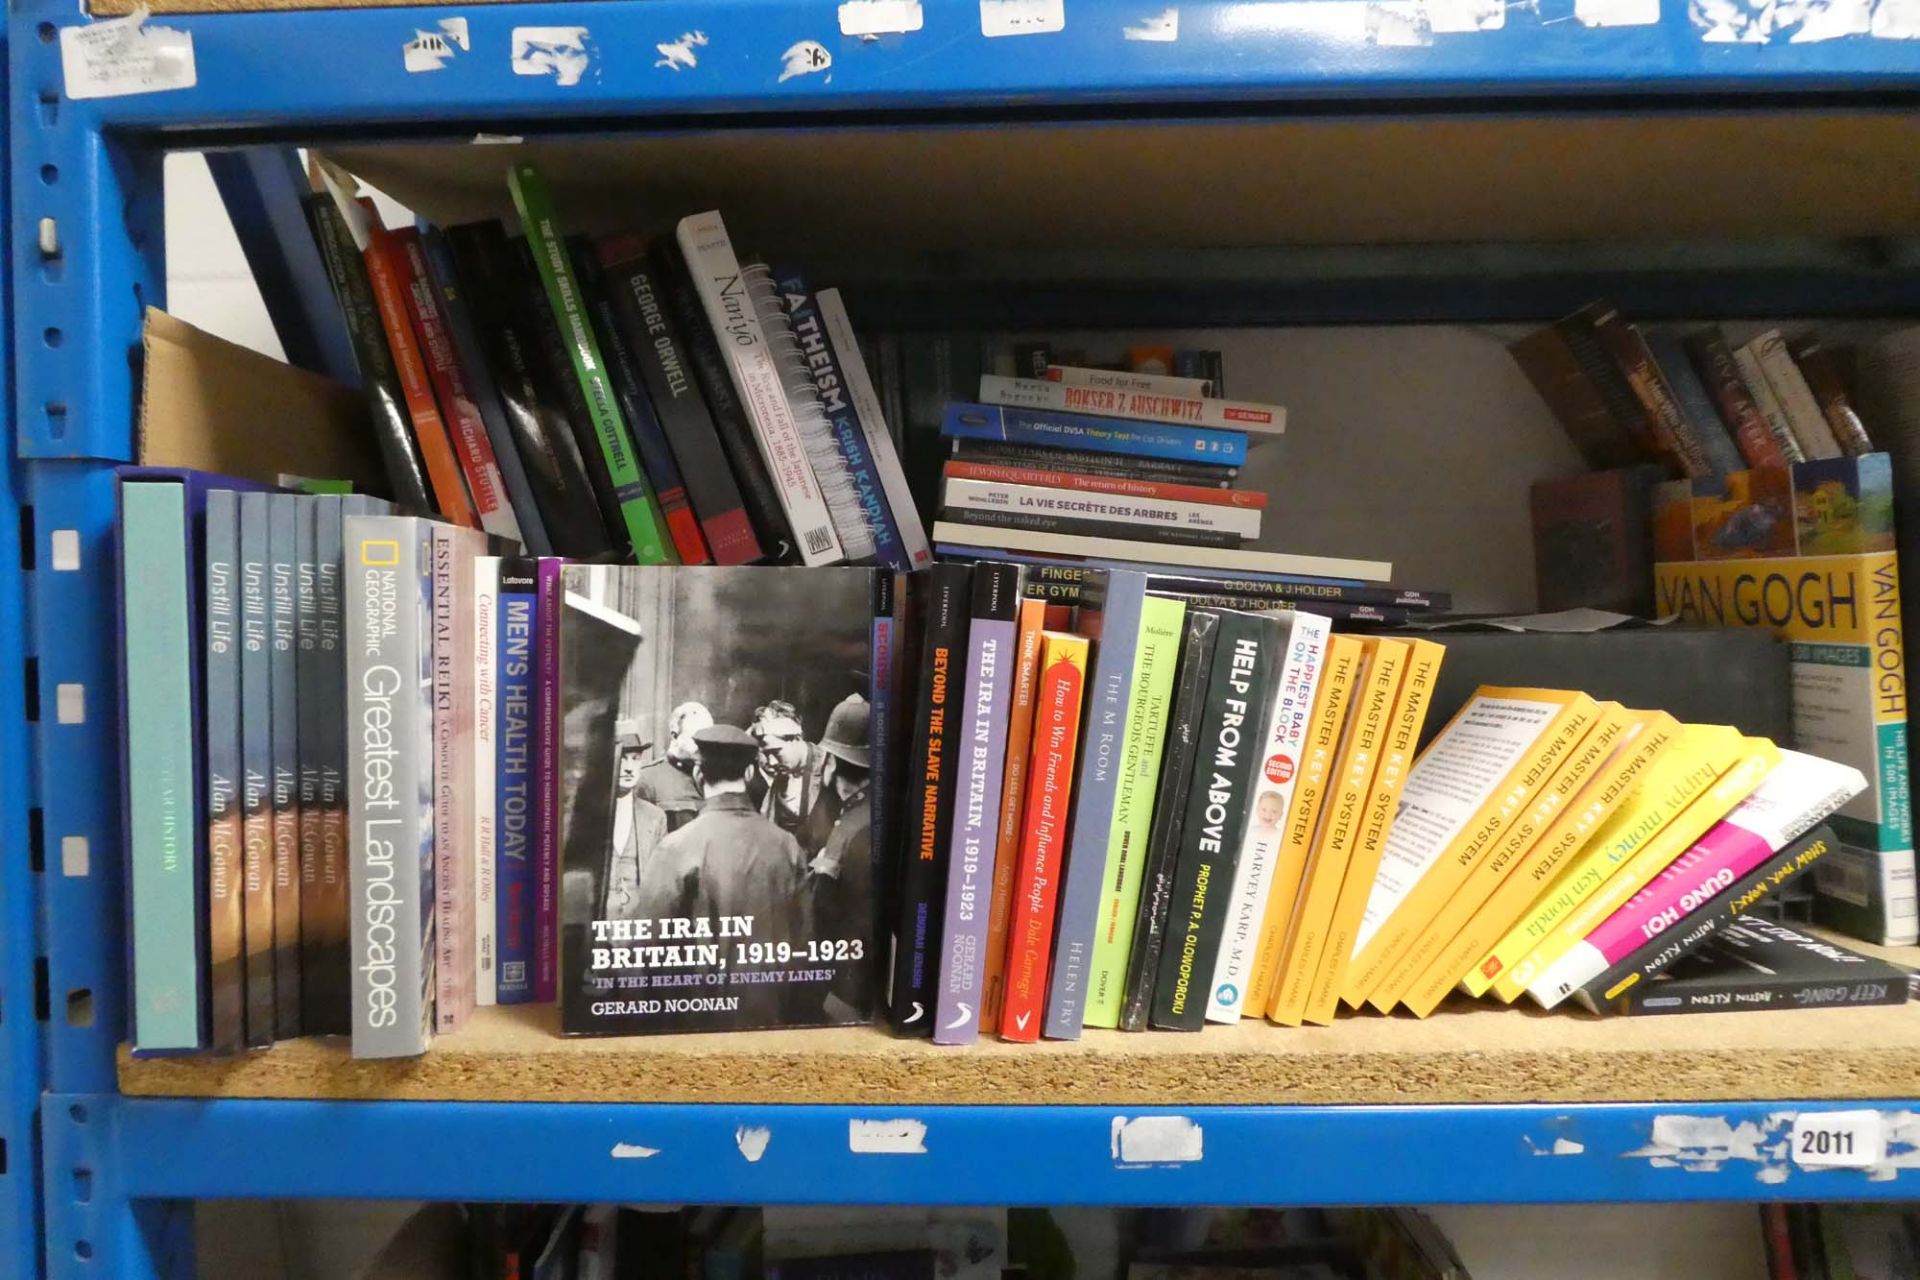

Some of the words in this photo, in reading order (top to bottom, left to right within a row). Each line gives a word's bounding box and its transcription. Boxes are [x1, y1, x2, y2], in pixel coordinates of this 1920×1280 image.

[539, 218, 554, 239] THE
[545, 239, 565, 273] STUDY
[556, 273, 577, 312] SKILLS
[567, 311, 597, 372] HANDBOOK
[628, 272, 666, 336] GEORGE
[651, 334, 690, 399] ORWELL
[1132, 378, 1153, 390] Free
[587, 373, 612, 417] STELLA
[601, 415, 629, 472] COTTRELL
[1129, 392, 1204, 422] AUSCHWITZ
[1033, 422, 1063, 435] Official
[1063, 424, 1085, 436] DVSA
[472, 463, 500, 511] STUTTLE
[833, 413, 865, 468] KRISH
[852, 467, 894, 548] KANDIAH
[1073, 477, 1088, 487] The
[1089, 479, 1117, 490] return
[1127, 482, 1157, 495] history
[963, 510, 994, 526] Beyond
[995, 513, 1012, 524] the
[1019, 496, 1034, 507] LA
[1036, 498, 1055, 509] VIE
[1056, 498, 1107, 515] SECRÈTE
[1110, 505, 1132, 517] DES
[1133, 507, 1179, 522] ARBRES
[211, 561, 230, 614] Unstill
[382, 570, 396, 638] NATIONAL
[434, 537, 452, 646] ESSENTIAL
[990, 571, 1000, 612] LIVERPOOL
[1050, 585, 1080, 598] GYM
[1274, 584, 1283, 593] &
[1733, 571, 1858, 630] GOGH
[1869, 561, 1898, 620] VAN
[365, 569, 381, 656] GEOGRAPHIC
[475, 593, 492, 664] Connecting
[1300, 626, 1320, 638] THE
[210, 620, 230, 653] Life
[504, 600, 528, 676] MEN'S
[1022, 629, 1035, 659] THINK
[1141, 642, 1156, 669] THE
[1290, 640, 1306, 662] ON
[931, 647, 949, 704] BEYOND
[979, 638, 997, 677] THE
[1226, 637, 1258, 695] HELP
[1294, 643, 1319, 708] HAPPIEST
[1331, 654, 1351, 685] THE
[1874, 626, 1906, 714] GOGH
[436, 655, 451, 712] REIKI
[478, 668, 492, 694] with
[976, 680, 993, 716] IRA
[1018, 660, 1032, 706] SMARTER
[1053, 678, 1070, 707] How
[1104, 671, 1122, 705] THE
[1283, 665, 1300, 693] THE
[478, 698, 492, 743] Cancer
[929, 707, 944, 735] THE
[1052, 709, 1066, 722] to
[1102, 709, 1116, 725] M
[1129, 671, 1151, 743] BOURGEOIS
[1141, 693, 1163, 756] TARTUFFE
[1273, 697, 1294, 745] BLOCK
[1316, 686, 1343, 747] MASTER
[362, 664, 401, 810] Greatest
[503, 684, 526, 775] HEALTH
[974, 719, 990, 742] IN
[1049, 724, 1065, 748] Win
[1213, 697, 1247, 768] FROM
[1285, 710, 1305, 748] BABY
[1894, 729, 1904, 747] HIS
[925, 738, 942, 782] SLAVE
[1093, 732, 1114, 782] ROOM
[1138, 758, 1152, 778] and
[1306, 747, 1327, 784] KEY
[1884, 745, 1895, 759] IN
[1895, 751, 1905, 770] LIFE
[964, 744, 987, 832] BRITAIN,
[1043, 751, 1062, 793] Friends
[1115, 743, 1139, 825] GENTLEMAN
[1661, 759, 1722, 817] happy
[1885, 762, 1896, 783] 500
[1897, 773, 1908, 799] AND
[212, 773, 230, 813] Alan
[1040, 794, 1056, 817] and
[1887, 785, 1899, 830] IMAGES
[503, 782, 525, 862] TODAY
[919, 784, 938, 862] NARRATIVE
[1197, 771, 1234, 855] ABOVE
[1289, 786, 1316, 847] SYSTEM
[1899, 800, 1910, 843] WORKS
[1030, 819, 1054, 873] Influence
[1600, 806, 1666, 869] money
[1790, 838, 1829, 870] SHOW
[212, 818, 231, 899] McGowan
[1243, 840, 1268, 899] HARVEY
[1027, 874, 1047, 913] People
[1190, 863, 1212, 911] PROPHET
[1569, 866, 1603, 899] ken
[1675, 862, 1737, 916] GUNG
[359, 819, 403, 1029] Landscapes
[591, 920, 652, 941] THE
[658, 917, 713, 940] IRA
[719, 916, 754, 937] IN
[1025, 919, 1042, 947] Dale
[1186, 921, 1200, 933] A.
[1189, 910, 1202, 921] P.
[1232, 901, 1254, 945] KARP,
[1523, 891, 1576, 941] honda
[1638, 902, 1681, 941] HO!
[1680, 916, 1717, 948] AUSTIN
[591, 944, 727, 970] BRITAIN,
[948, 933, 966, 994] NOONAN
[959, 933, 977, 991] GERARD
[1014, 948, 1039, 1001] Carnegie
[1063, 940, 1084, 993] HELEN
[1169, 933, 1198, 1015] OLOWOPOROKU
[1224, 946, 1243, 981] M.D.
[1641, 940, 1683, 977] KLEON
[618, 976, 648, 989] THE
[651, 975, 703, 987] HEART
[706, 973, 727, 986] OF
[730, 971, 785, 984] ENEMY
[1095, 968, 1110, 997] DOVER
[1689, 991, 1732, 1006] KLEON
[1734, 990, 1773, 1004] AUSTIN
[1848, 983, 1888, 1001] KEEP
[591, 999, 661, 1016] GERARD
[664, 997, 740, 1013] NOONAN
[1058, 998, 1075, 1028] FRY
[1802, 1130, 1854, 1155] 2011
